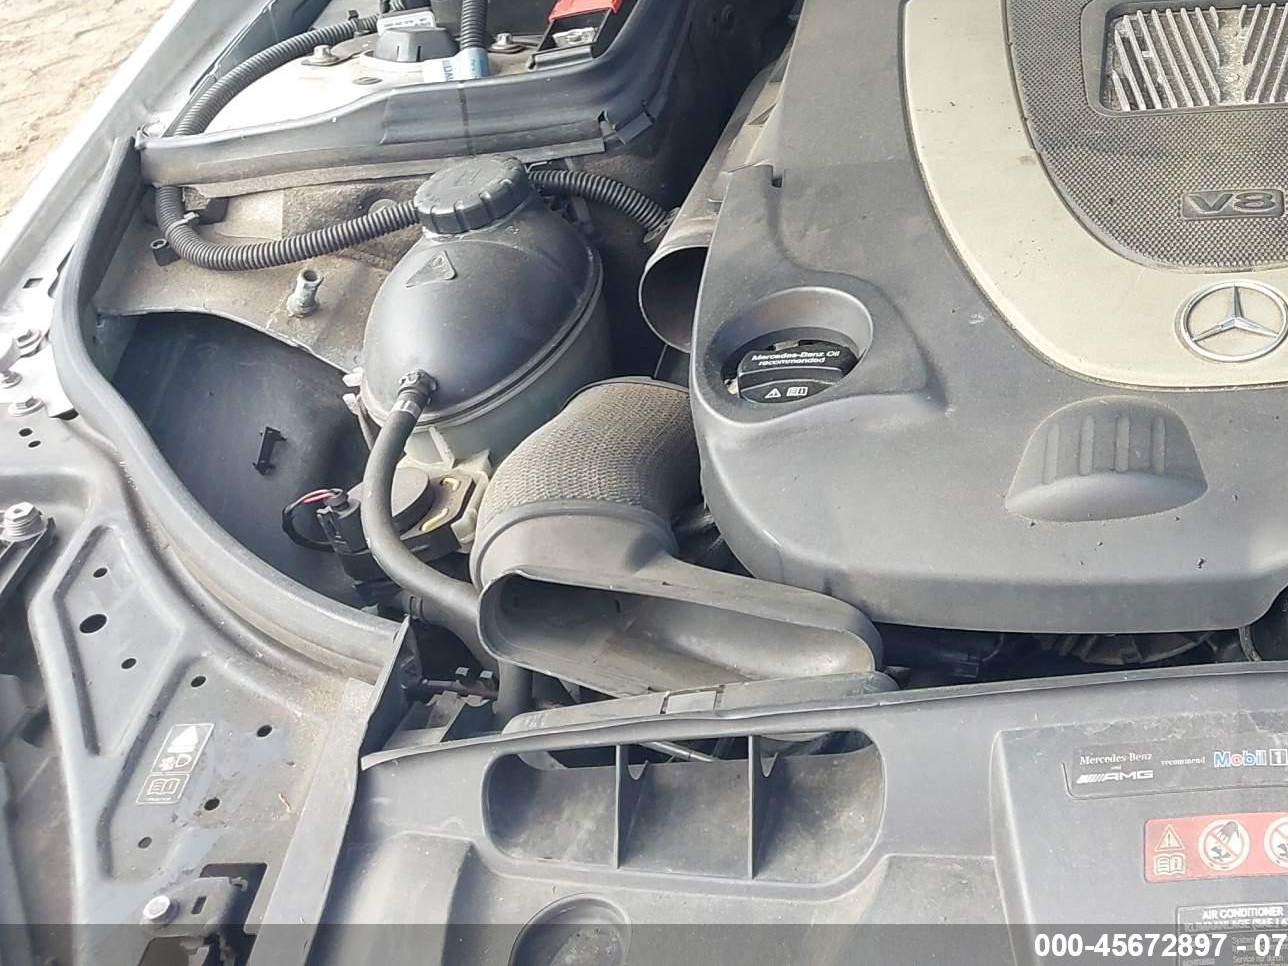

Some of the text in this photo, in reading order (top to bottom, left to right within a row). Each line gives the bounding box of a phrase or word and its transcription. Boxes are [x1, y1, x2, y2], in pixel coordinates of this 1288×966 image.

[1186, 192, 1278, 214] V8
[758, 357, 826, 366] recommended
[1080, 753, 1153, 765] Mercedes-Benz
[1213, 750, 1267, 768] Mobil
[1202, 907, 1285, 920] AIR CONDITIONER
